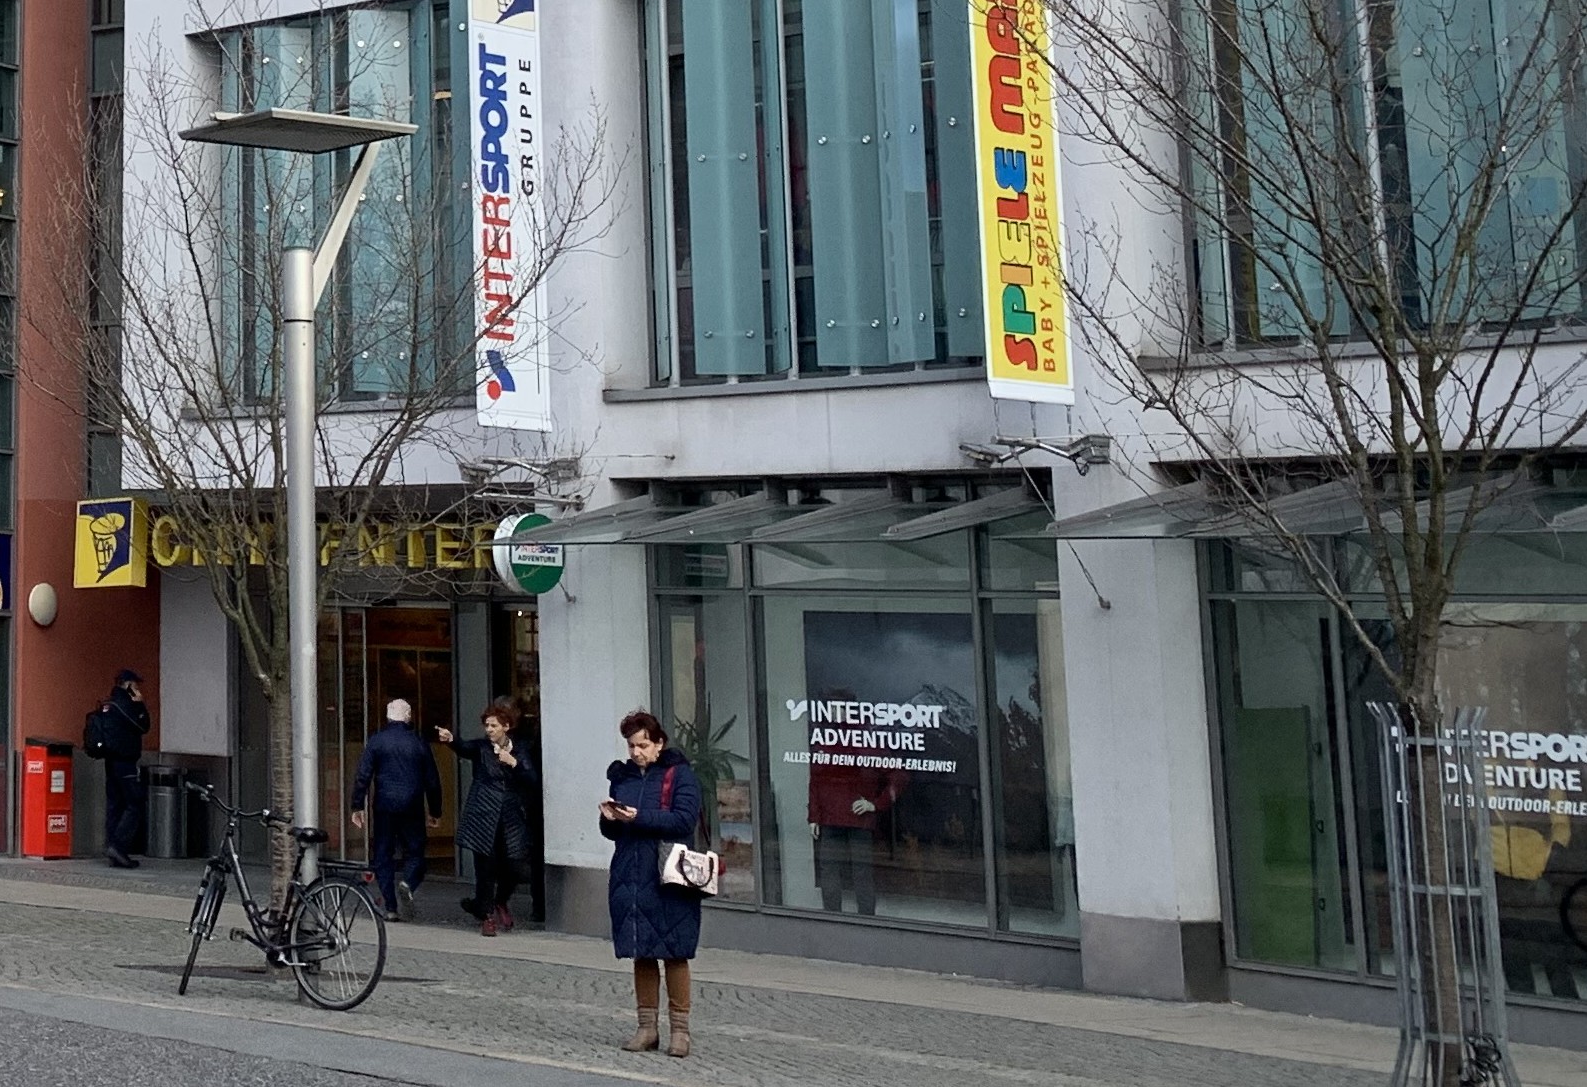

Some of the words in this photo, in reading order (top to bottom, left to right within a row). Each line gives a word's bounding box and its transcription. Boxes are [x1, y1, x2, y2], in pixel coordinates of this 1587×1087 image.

[519, 59, 535, 197] GRUPPE
[479, 42, 515, 342] INTERSPORT
[994, 146, 1038, 372] SPIELE
[1040, 298, 1056, 372] BABY
[810, 728, 925, 751] ADVENTURE
[811, 700, 944, 728] INTERSPORT
[783, 752, 811, 763] ALLES
[812, 751, 830, 765] FÜR
[831, 754, 855, 766] DEIN
[856, 755, 957, 773] OUTDOOR-ERLEBNIS!
